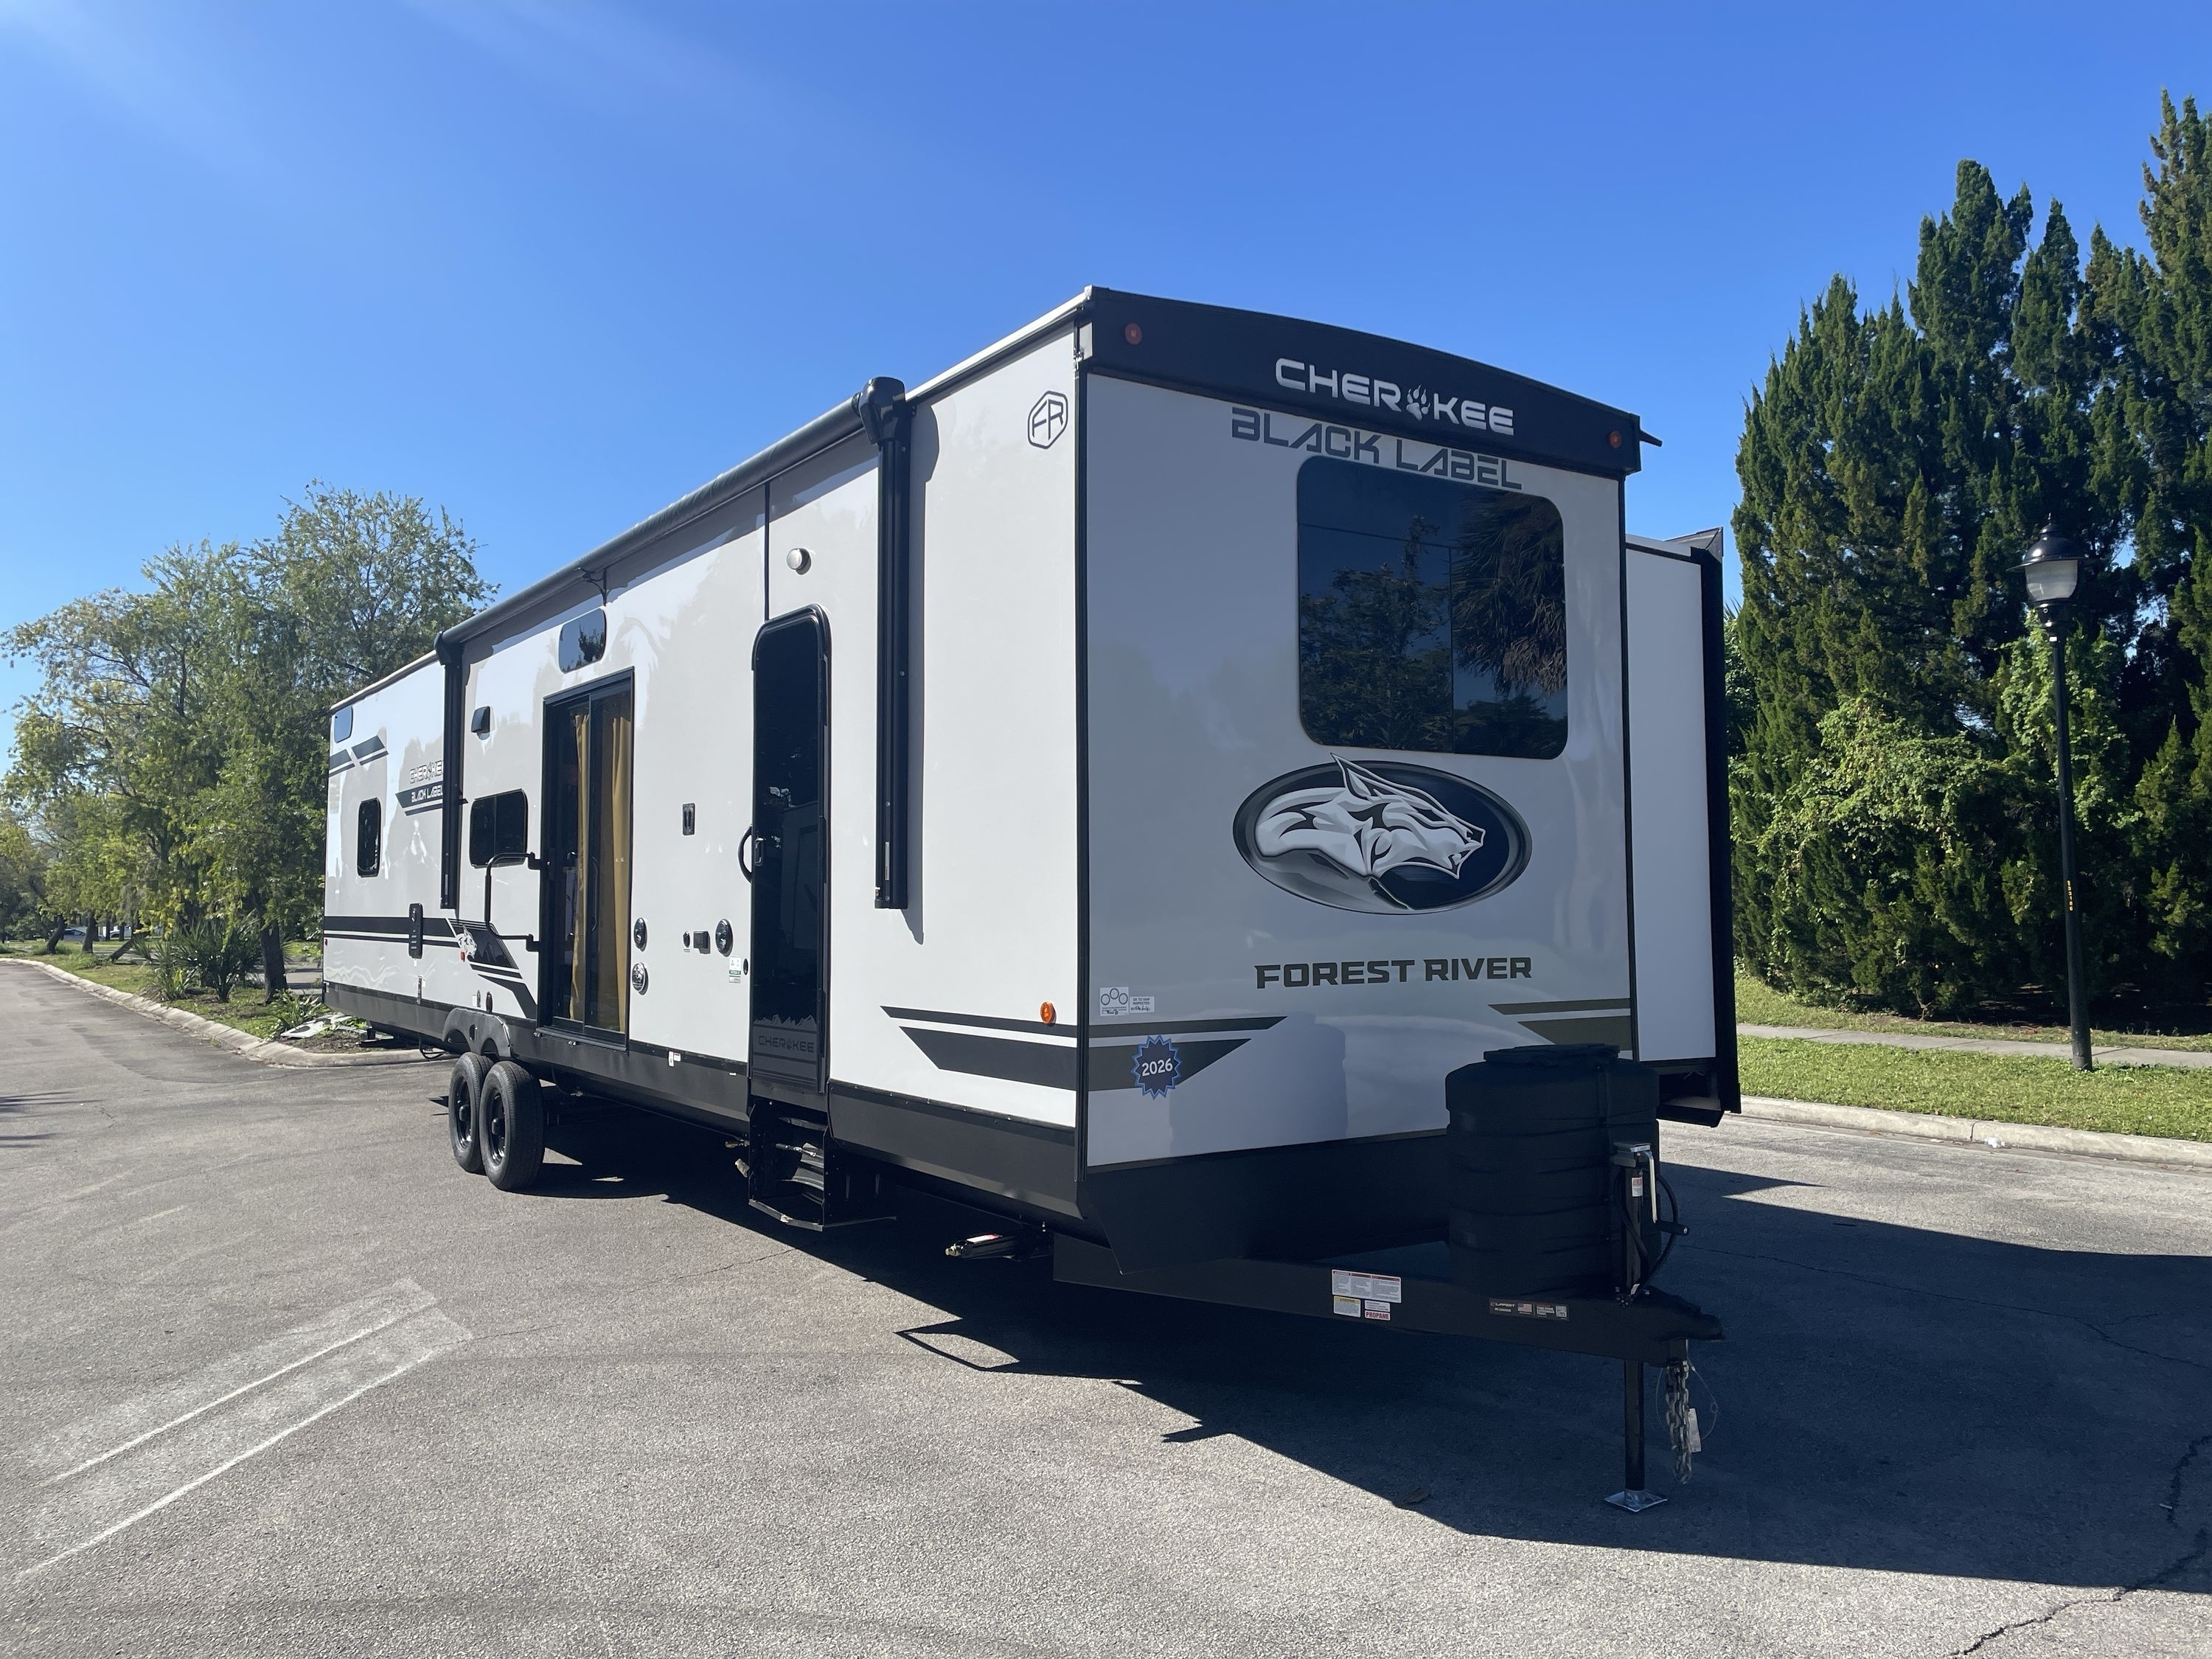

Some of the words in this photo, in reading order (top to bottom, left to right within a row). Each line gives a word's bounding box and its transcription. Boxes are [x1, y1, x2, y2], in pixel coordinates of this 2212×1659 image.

[1231, 407, 1382, 464] BLACK
[1397, 439, 1523, 490] LABEL
[1253, 959, 1416, 990] FOREST
[1423, 957, 1533, 982] RIVER
[1141, 1058, 1173, 1077] 2026
[1366, 1311, 1390, 1320] PROPANE
